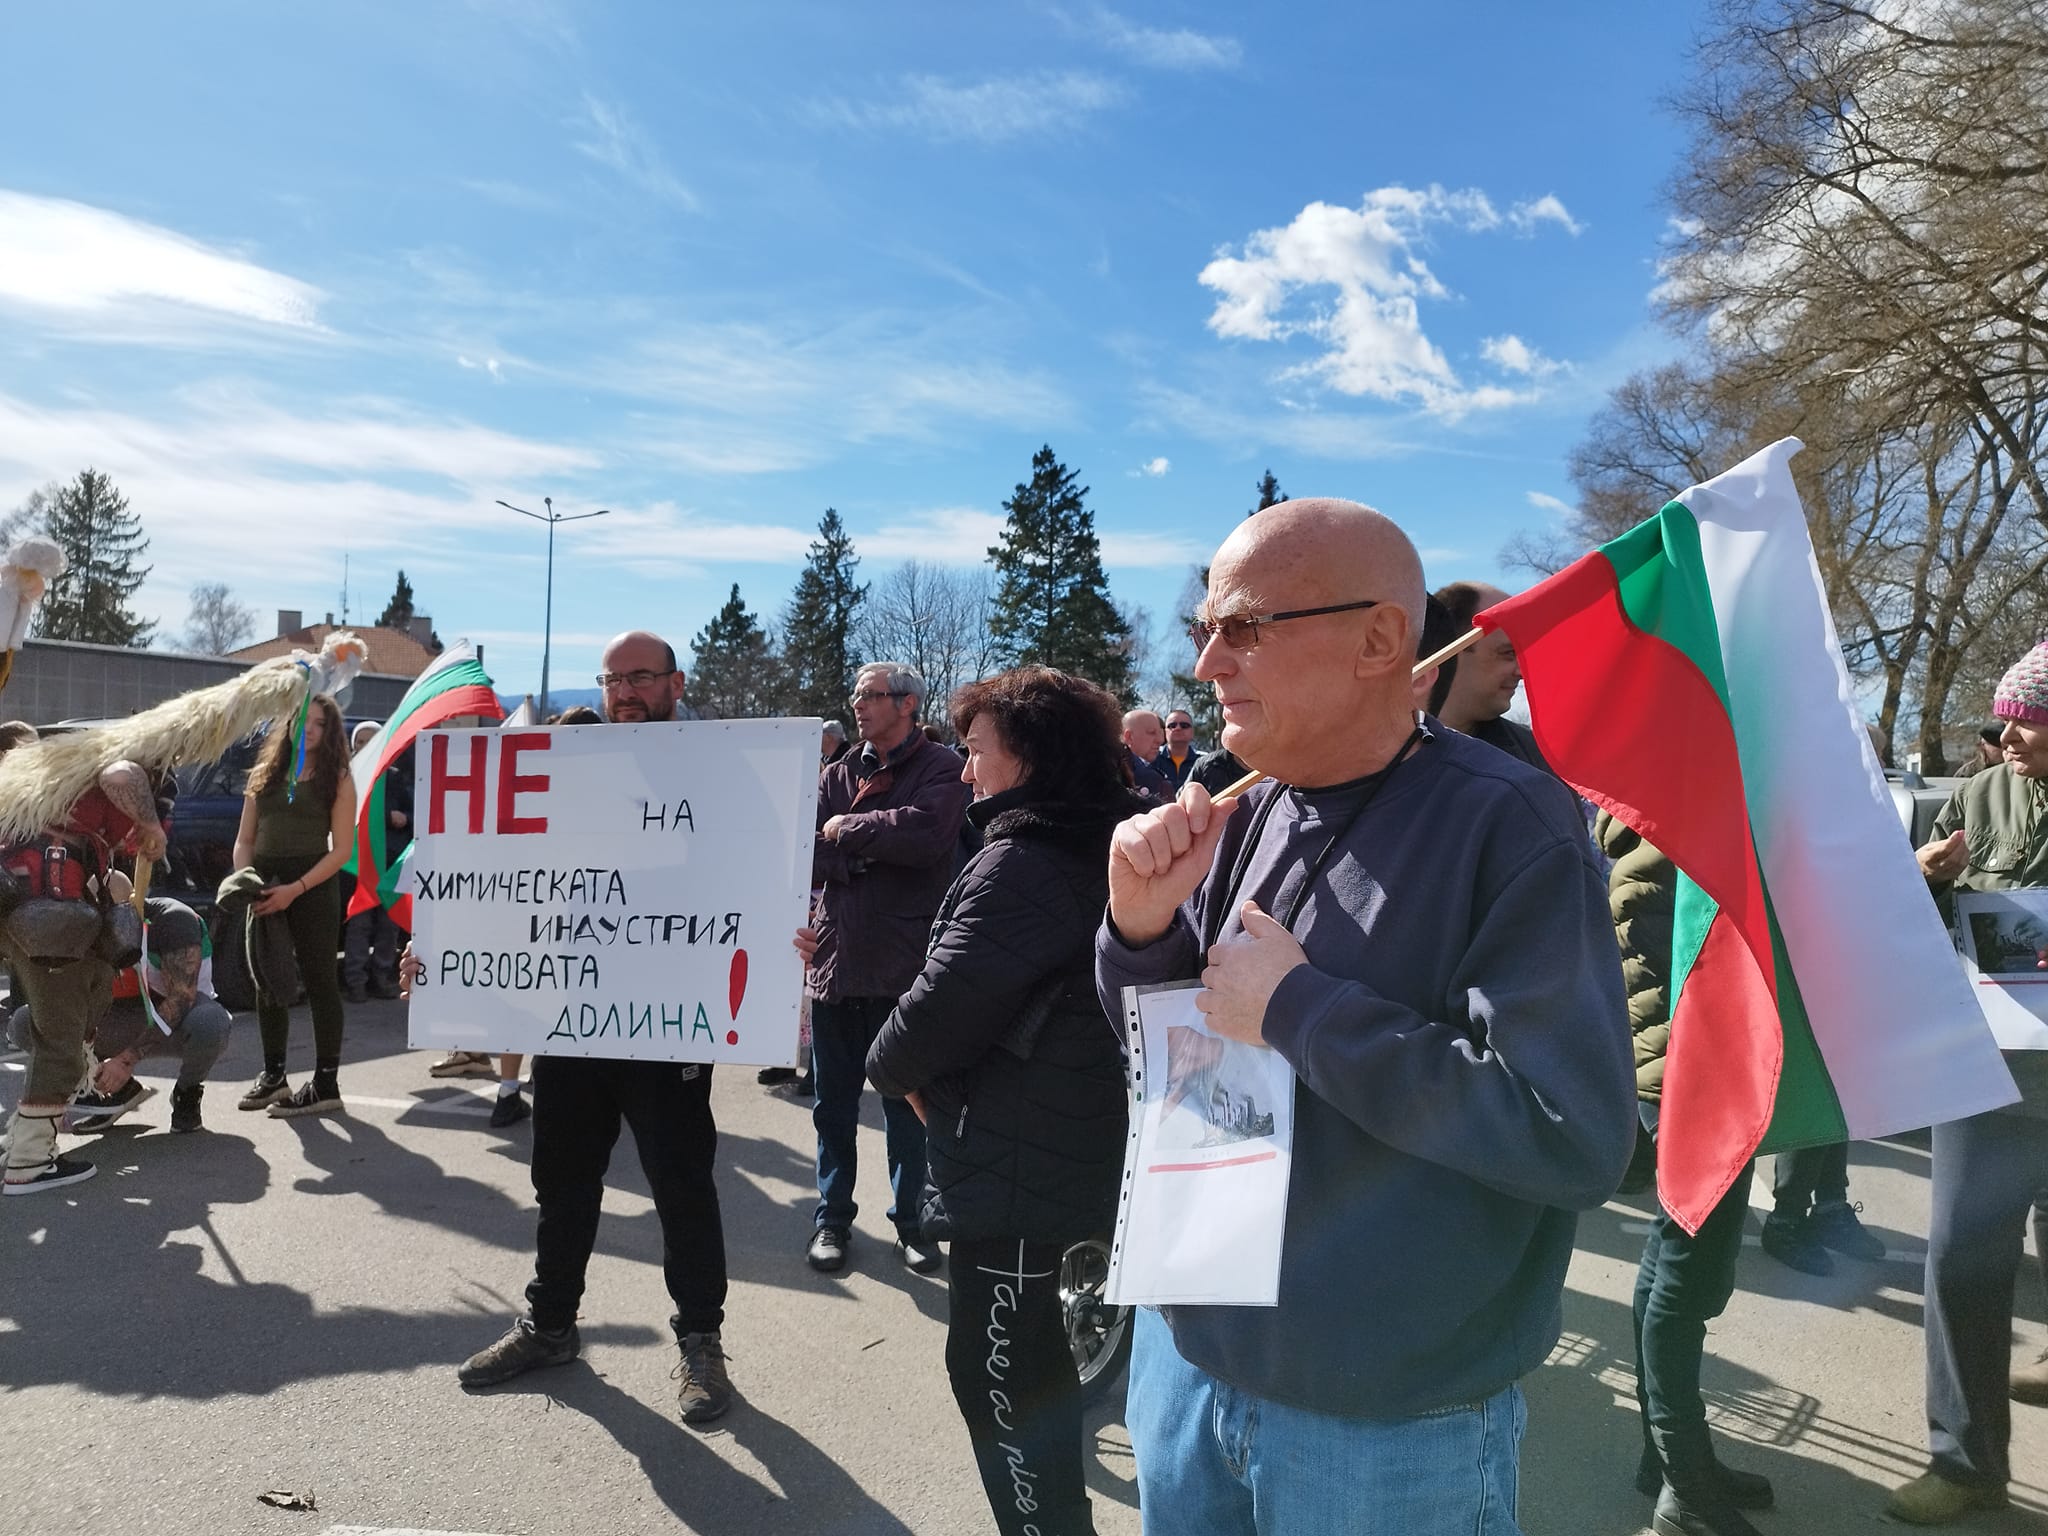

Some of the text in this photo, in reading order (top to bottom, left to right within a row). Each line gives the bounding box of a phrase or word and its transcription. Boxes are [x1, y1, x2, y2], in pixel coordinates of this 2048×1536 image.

[428, 733, 695, 835] НЕ НА
[415, 868, 627, 906] ХИМИЧЕСКАТА
[530, 912, 742, 946] ИНДУСТРИЯ
[441, 951, 599, 990] РОЗОВАТА
[989, 1389, 1013, 1430] a
[999, 1442, 1038, 1514] nice
